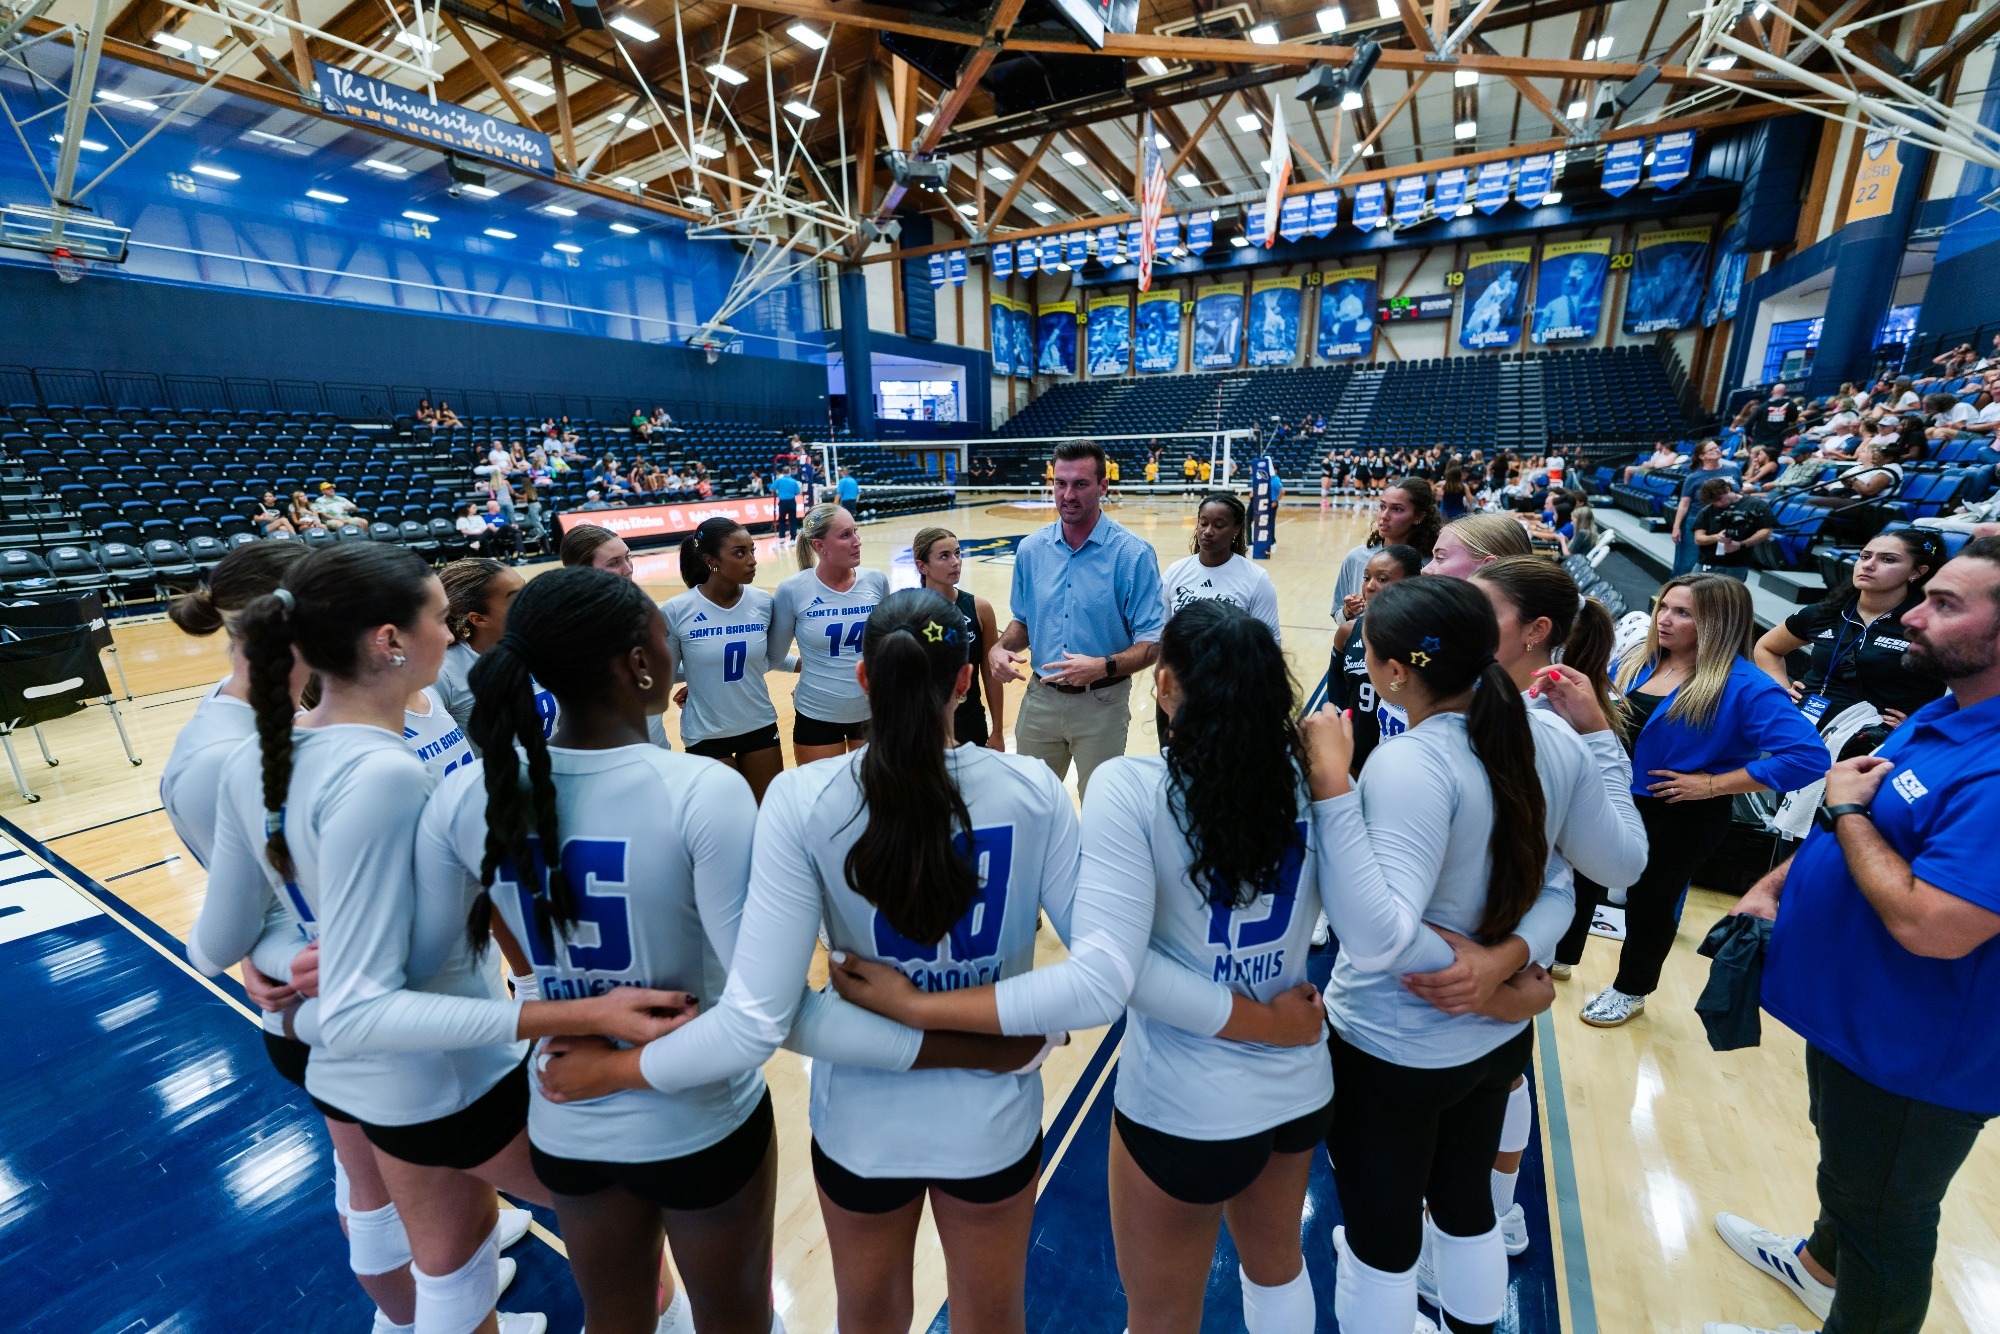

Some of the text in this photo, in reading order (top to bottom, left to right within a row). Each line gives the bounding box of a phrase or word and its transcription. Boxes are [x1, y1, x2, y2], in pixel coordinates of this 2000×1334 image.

[327, 67, 543, 156] The University Center
[346, 103, 540, 169] www.ucen.ucsb.edu
[167, 172, 197, 193] 13
[1855, 183, 1880, 204] 22
[412, 222, 431, 240] 14
[1610, 253, 1634, 269] 20
[1305, 272, 1321, 286] 18
[1446, 272, 1465, 286] 19
[1182, 301, 1195, 313] 17
[1076, 313, 1088, 324] 16
[1257, 482, 1269, 542] UCSB
[630, 516, 665, 530] Kitchen
[806, 604, 877, 618] SANTA BARBAR
[689, 626, 723, 639] SANTA
[824, 620, 867, 657] 14
[1875, 635, 1911, 649] UCSB
[723, 640, 747, 683] 0
[1359, 682, 1375, 713] 9
[416, 743, 442, 763] NTA
[1898, 769, 1929, 799] UCSB
[1213, 949, 1286, 985] MATHIS
